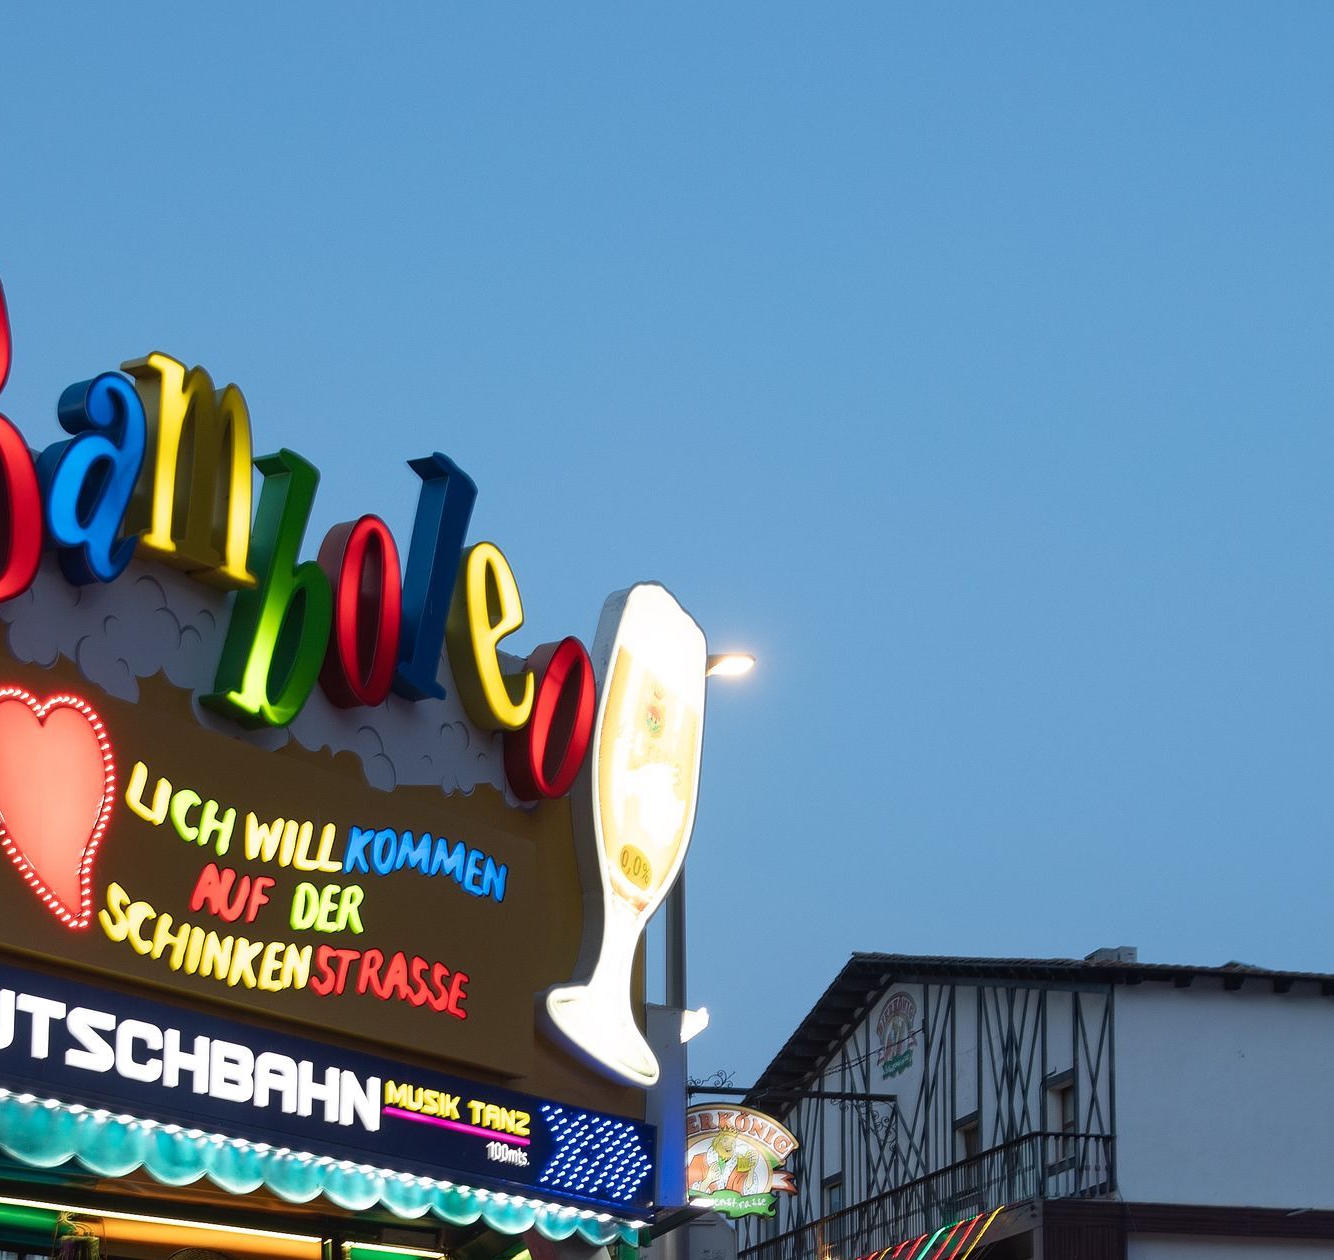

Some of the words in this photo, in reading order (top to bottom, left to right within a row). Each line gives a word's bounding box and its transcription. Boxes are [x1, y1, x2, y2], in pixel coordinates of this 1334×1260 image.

[621, 850, 650, 885] 0,0%
[189, 861, 275, 923] AUF
[289, 881, 365, 934] DER
[384, 1080, 461, 1120] MUSIK
[467, 1100, 530, 1136] TANZ
[687, 1111, 792, 1154] ERKÖNIG
